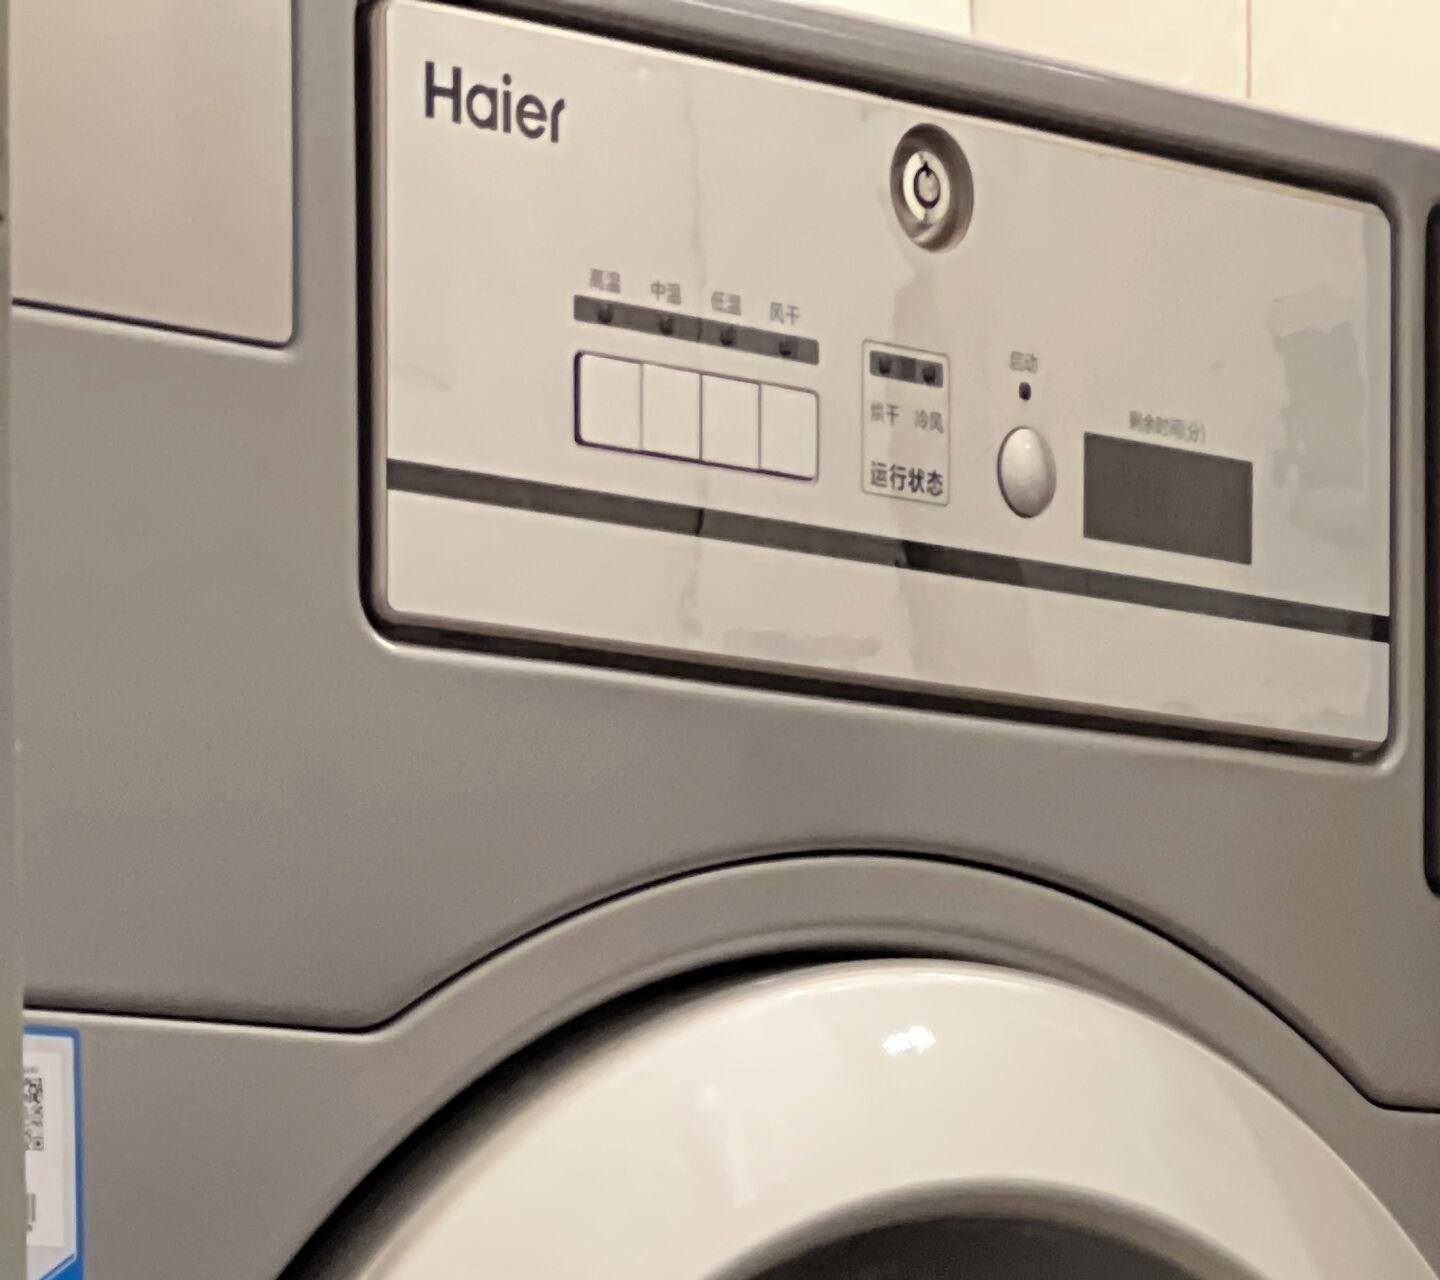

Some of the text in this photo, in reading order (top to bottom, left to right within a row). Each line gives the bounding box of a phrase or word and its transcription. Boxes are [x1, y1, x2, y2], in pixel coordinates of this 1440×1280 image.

[424, 61, 565, 143] Haier
[650, 280, 682, 304] 中温
[769, 301, 800, 326] 风干
[869, 463, 944, 497] 运行状态
